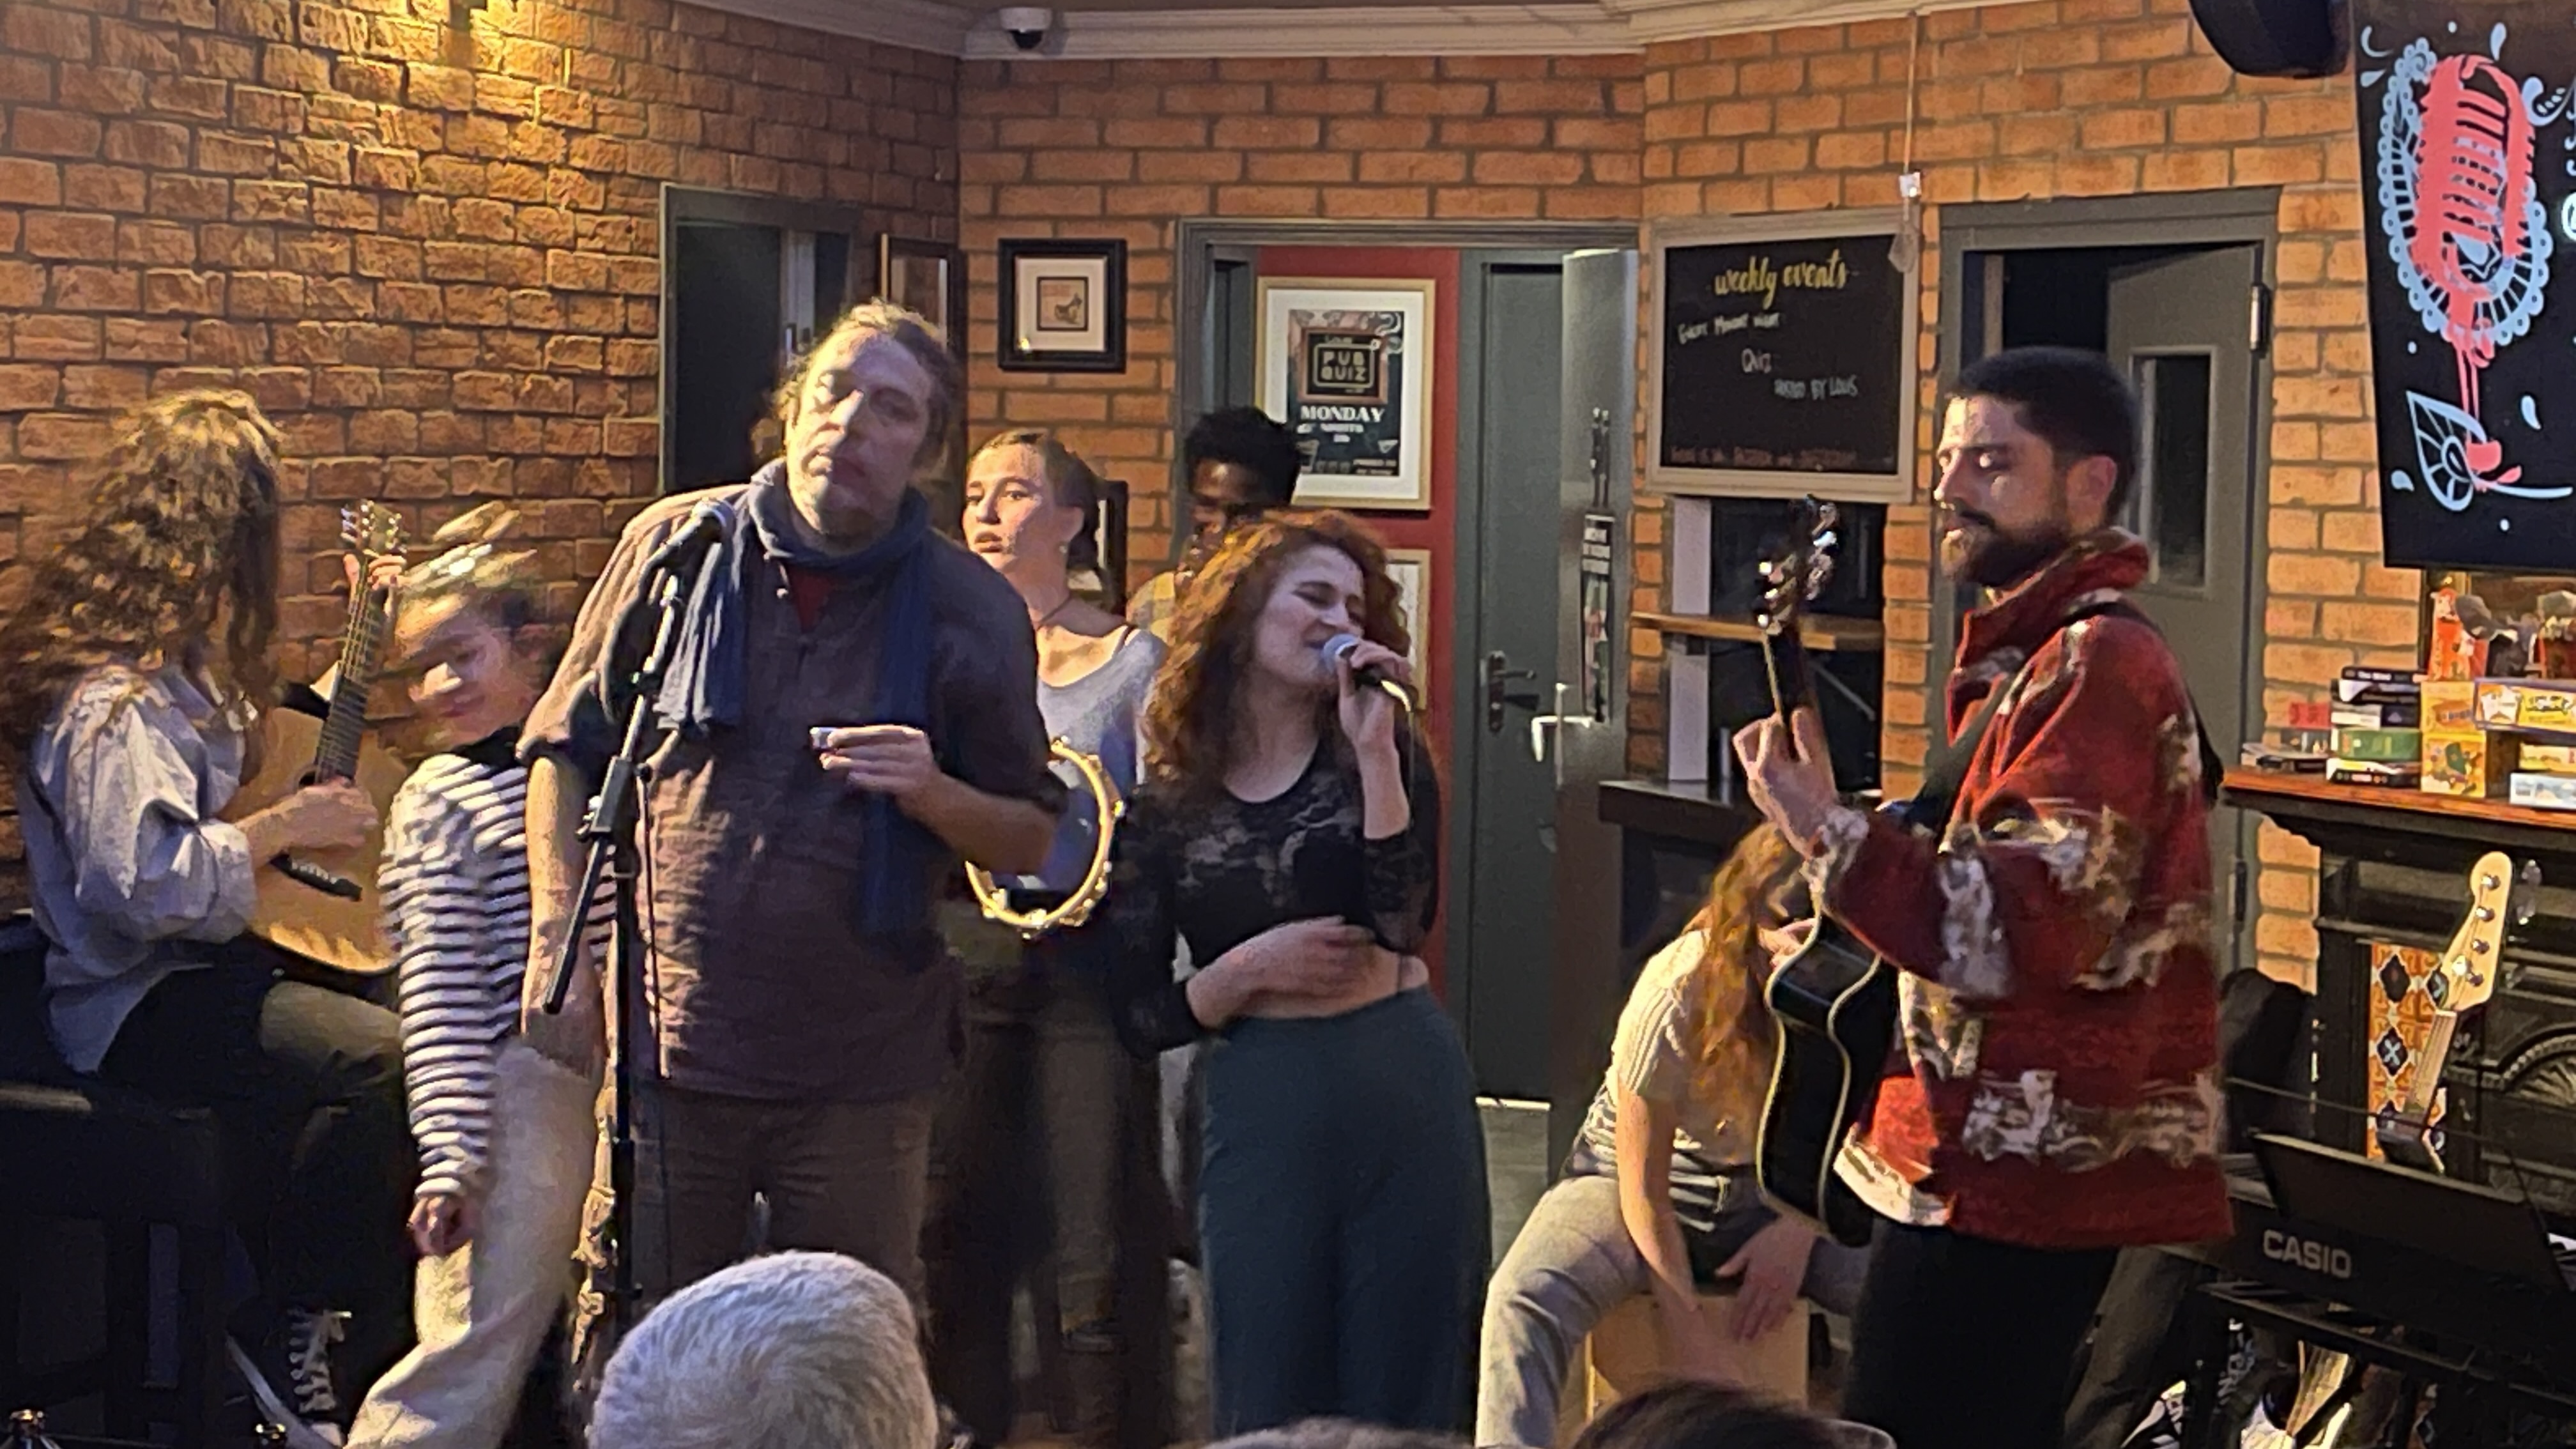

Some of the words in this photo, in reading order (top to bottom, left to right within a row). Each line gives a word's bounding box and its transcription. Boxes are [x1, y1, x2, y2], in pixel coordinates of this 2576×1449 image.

[1715, 256, 1777, 310] weekly
[1783, 249, 1846, 288] events
[1323, 351, 1365, 366] PUB
[1321, 366, 1366, 381] QUIZ
[1301, 405, 1385, 422] MONDAY
[2264, 1229, 2352, 1278] CASIO
